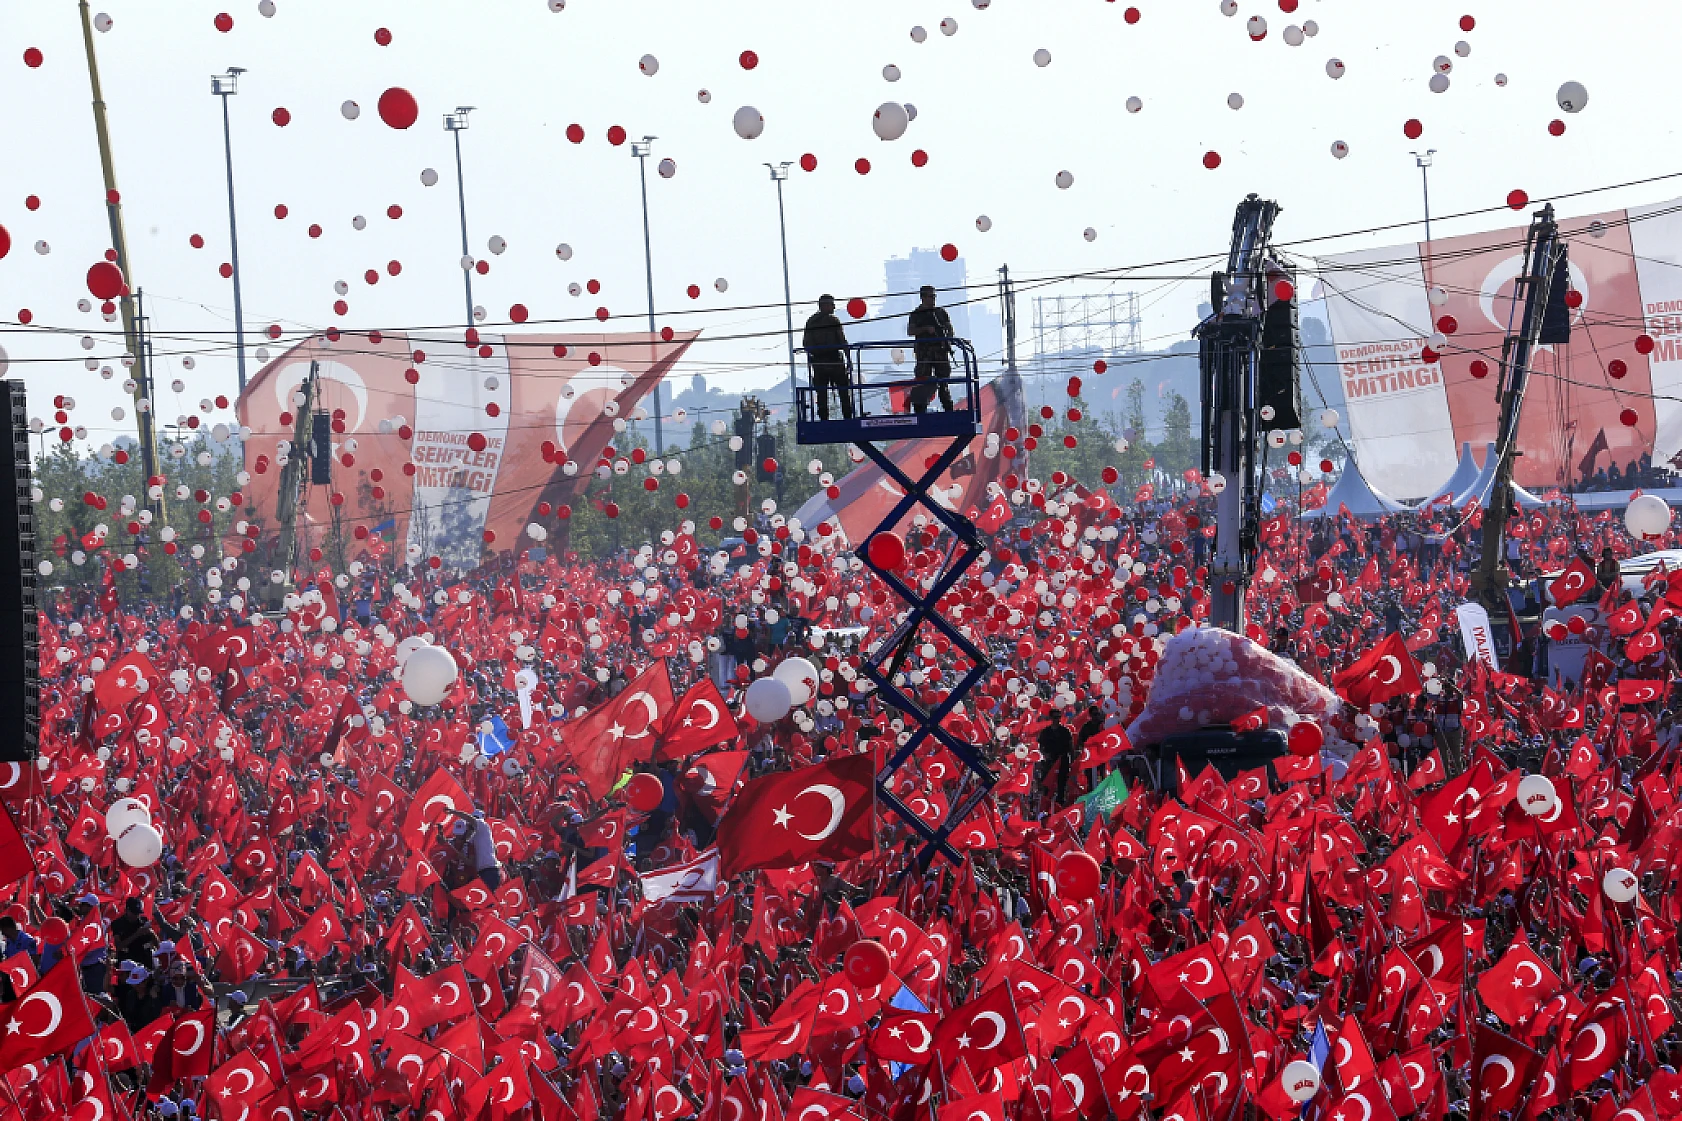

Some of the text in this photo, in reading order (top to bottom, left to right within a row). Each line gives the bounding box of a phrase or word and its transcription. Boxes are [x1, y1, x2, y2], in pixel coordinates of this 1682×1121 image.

[1343, 352, 1430, 378] ŞEHİTLE
[1346, 367, 1439, 397] MİTİNGİ
[488, 437, 502, 449] VE
